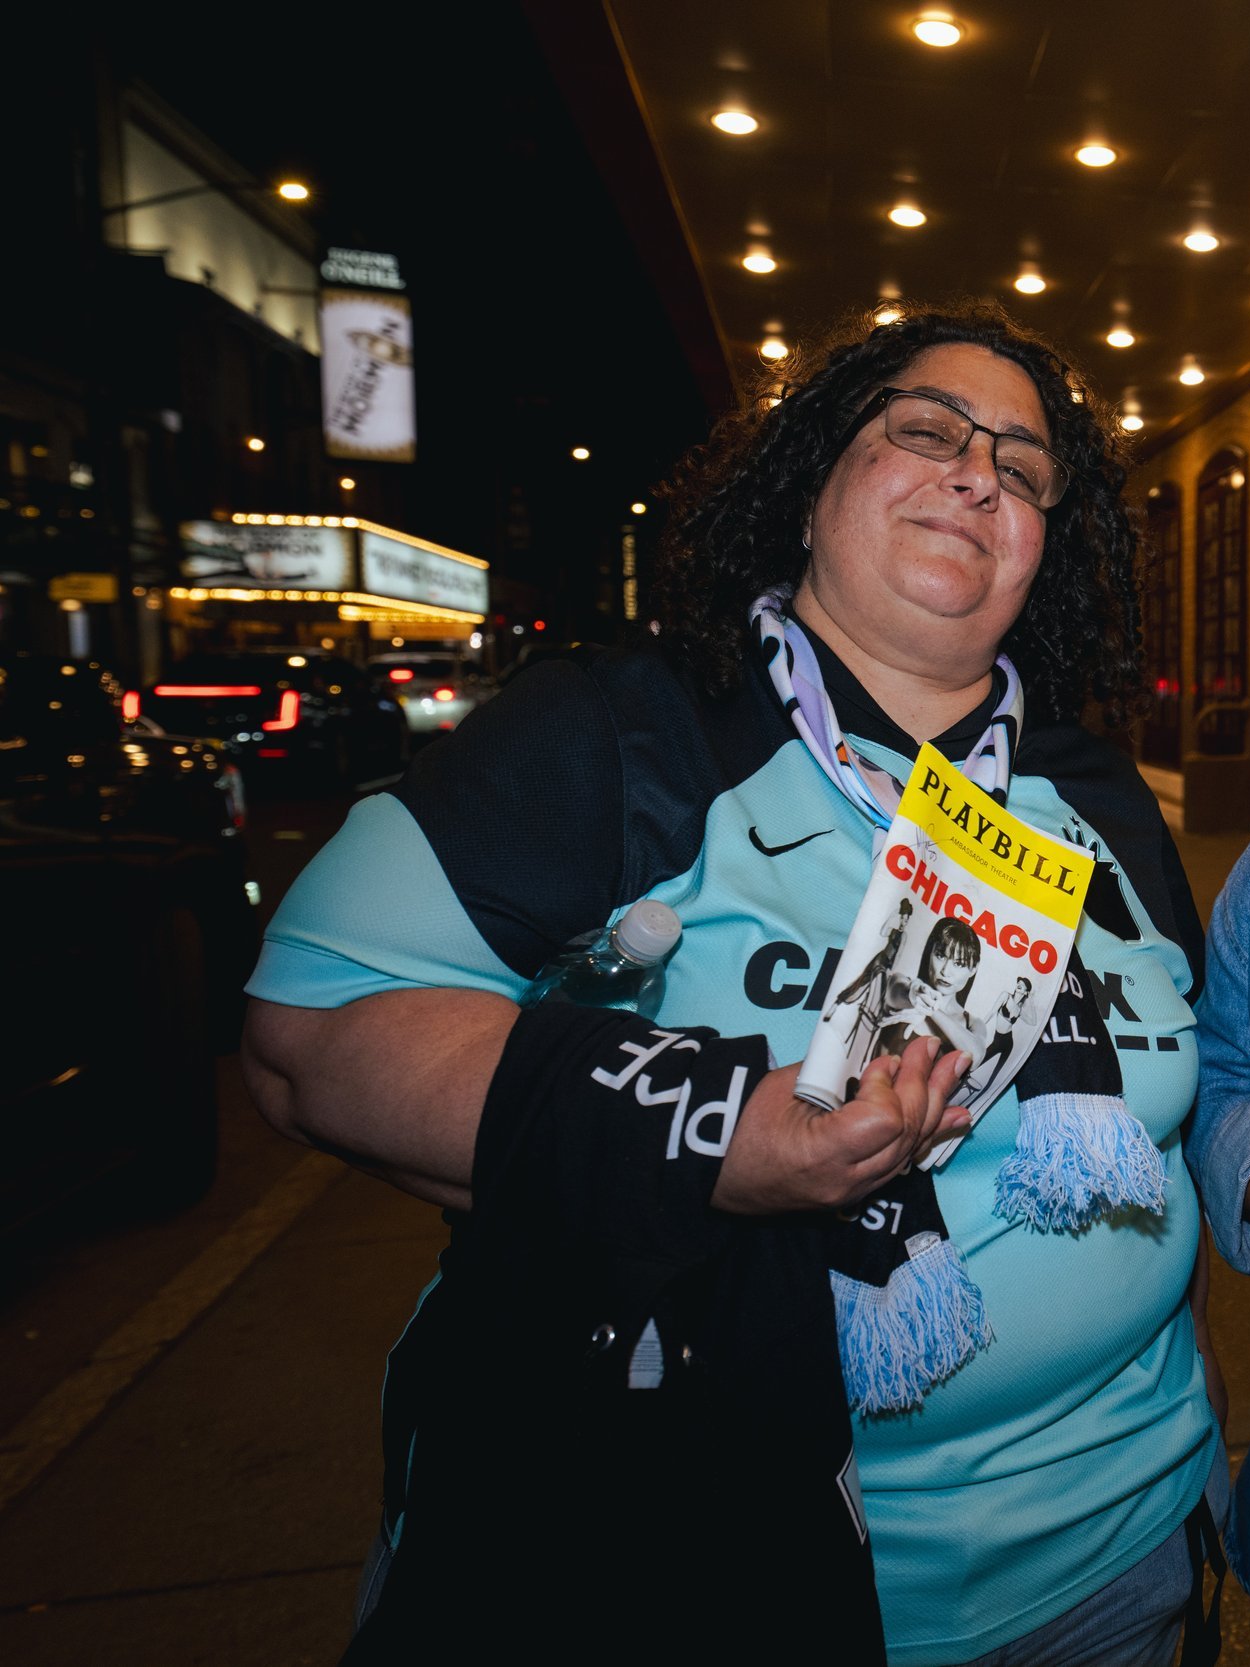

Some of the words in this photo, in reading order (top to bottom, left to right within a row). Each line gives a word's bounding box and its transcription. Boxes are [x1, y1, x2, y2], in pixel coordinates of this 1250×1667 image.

[919, 766, 1077, 897] PLAYBILL
[950, 836, 988, 868] AMBASSADOR
[990, 865, 1018, 887] THEATRE
[885, 844, 1058, 975] CHICAGO
